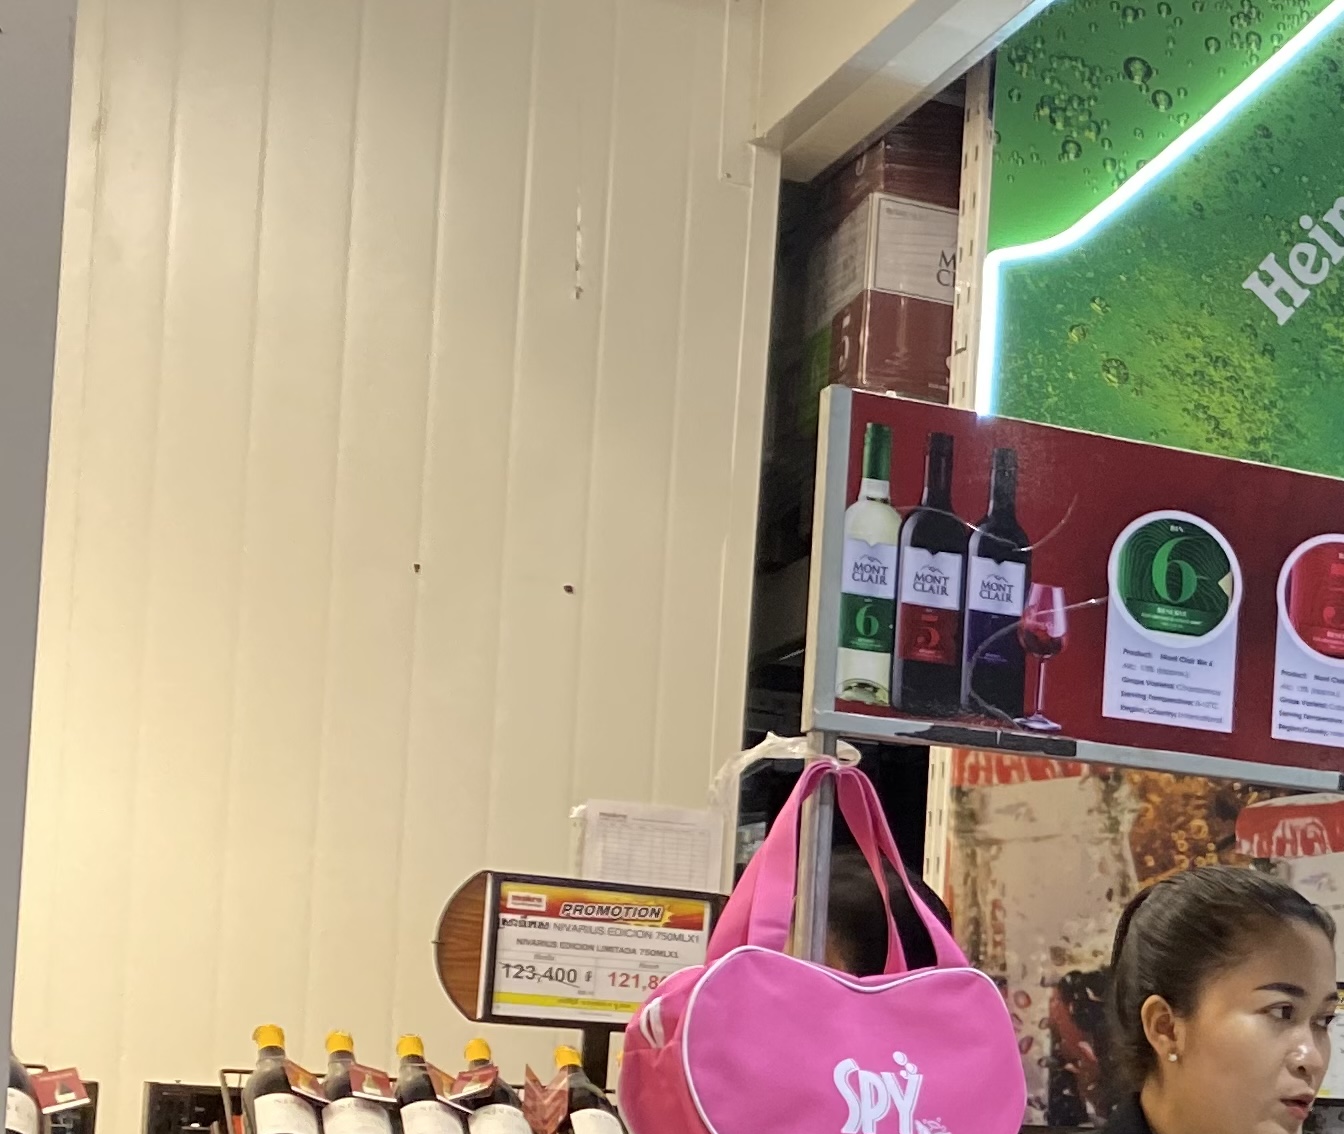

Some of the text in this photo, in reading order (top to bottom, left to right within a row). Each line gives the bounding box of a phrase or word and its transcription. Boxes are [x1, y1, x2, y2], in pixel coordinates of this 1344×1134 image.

[853, 561, 888, 575] MONT
[1152, 536, 1200, 604] 6
[852, 572, 887, 585] CLAIR
[914, 572, 949, 585] MONT
[913, 583, 948, 596] CLAIR
[981, 580, 1015, 592] MONT
[855, 604, 879, 637] 6
[560, 902, 663, 919] PROMOTION
[502, 963, 578, 984] 123,400
